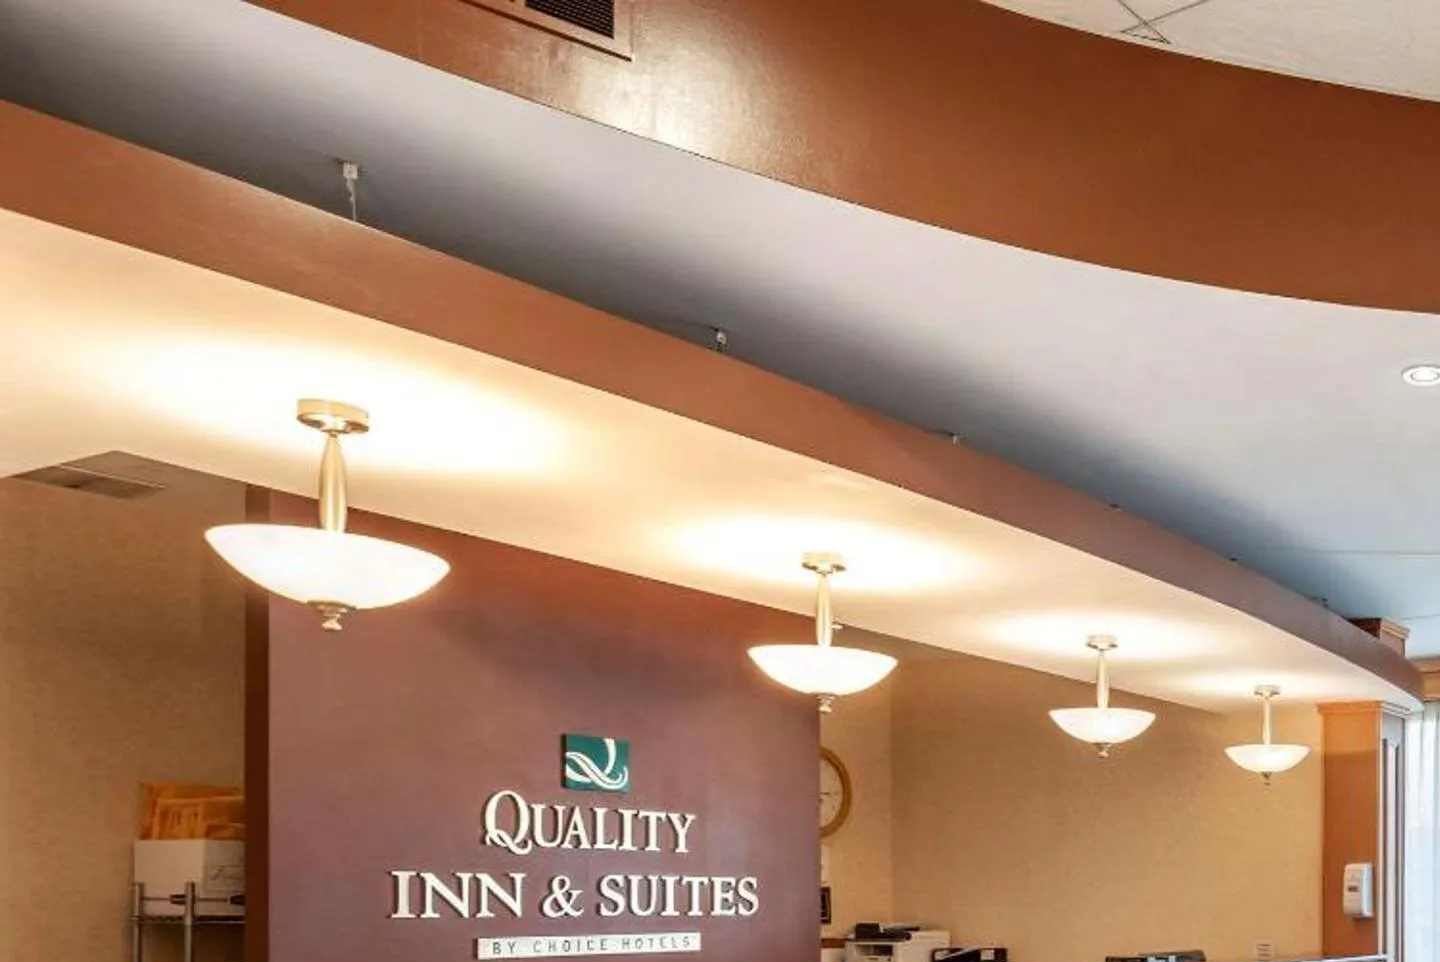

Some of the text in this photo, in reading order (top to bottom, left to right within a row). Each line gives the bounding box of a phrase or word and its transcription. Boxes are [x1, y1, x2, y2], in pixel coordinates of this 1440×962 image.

[485, 789, 696, 854] QUALITY
[391, 871, 760, 919] INN & SUITES
[492, 936, 692, 955] BY CHOICE HOTELS
